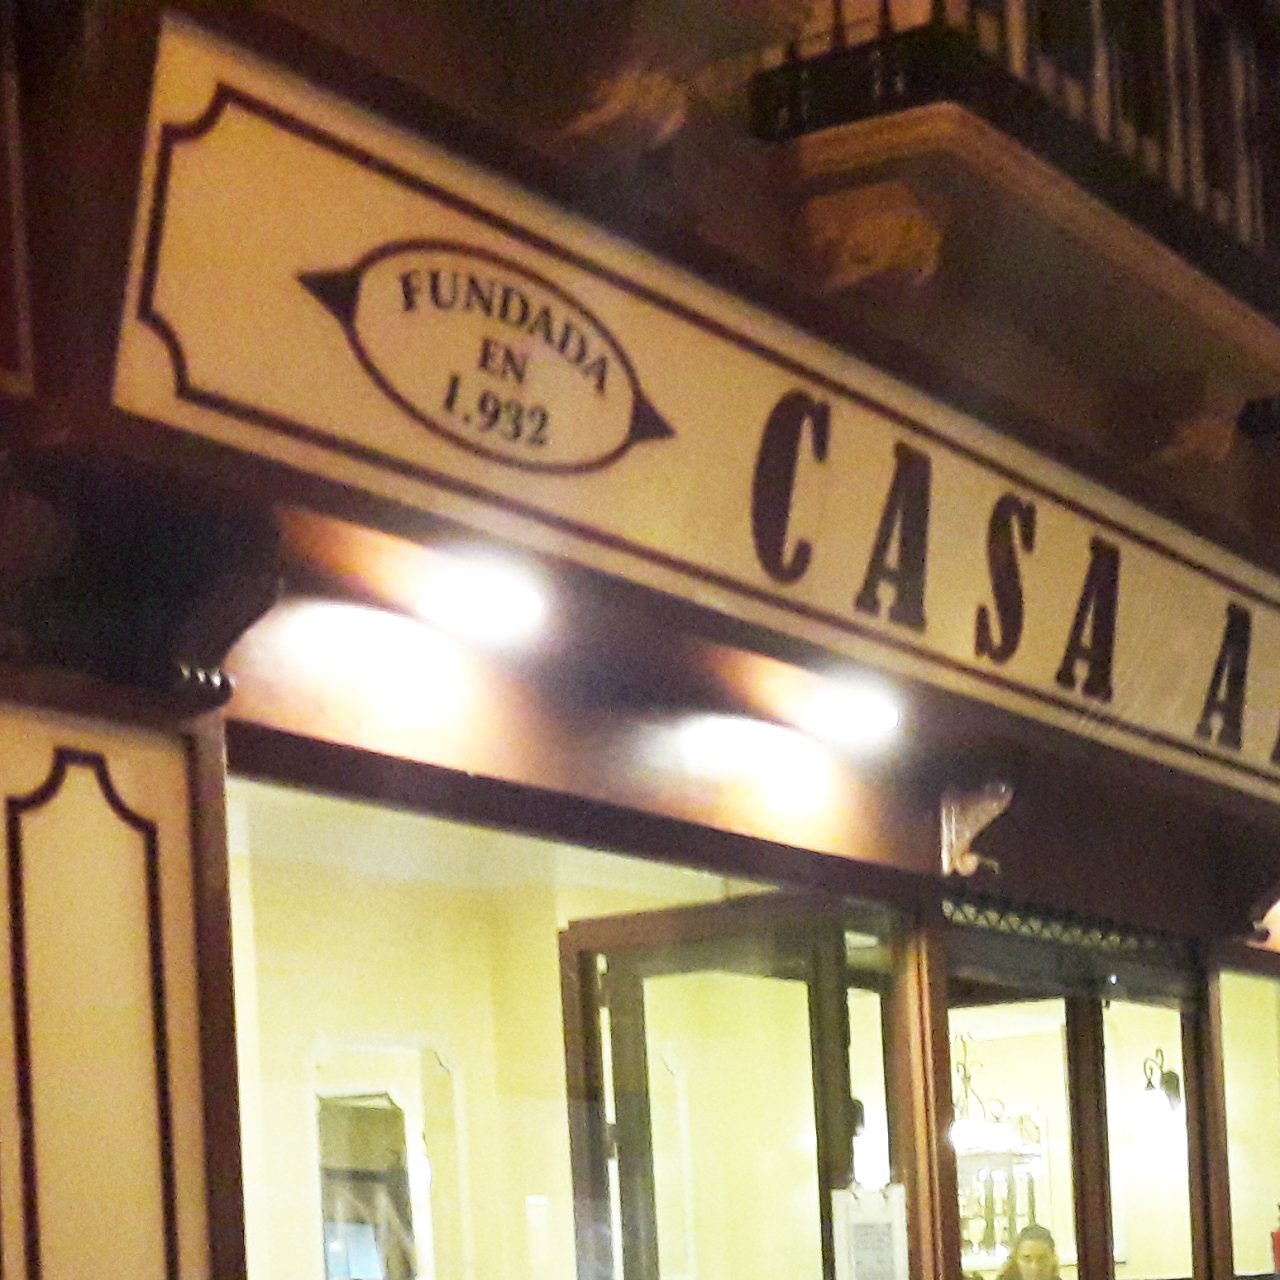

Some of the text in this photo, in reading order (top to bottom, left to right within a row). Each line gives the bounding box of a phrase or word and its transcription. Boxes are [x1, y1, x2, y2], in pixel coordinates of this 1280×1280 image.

[400, 269, 611, 396] FUNDADA
[478, 338, 529, 385] EN
[443, 374, 552, 447] 1.932
[750, 387, 1120, 703] CASA
